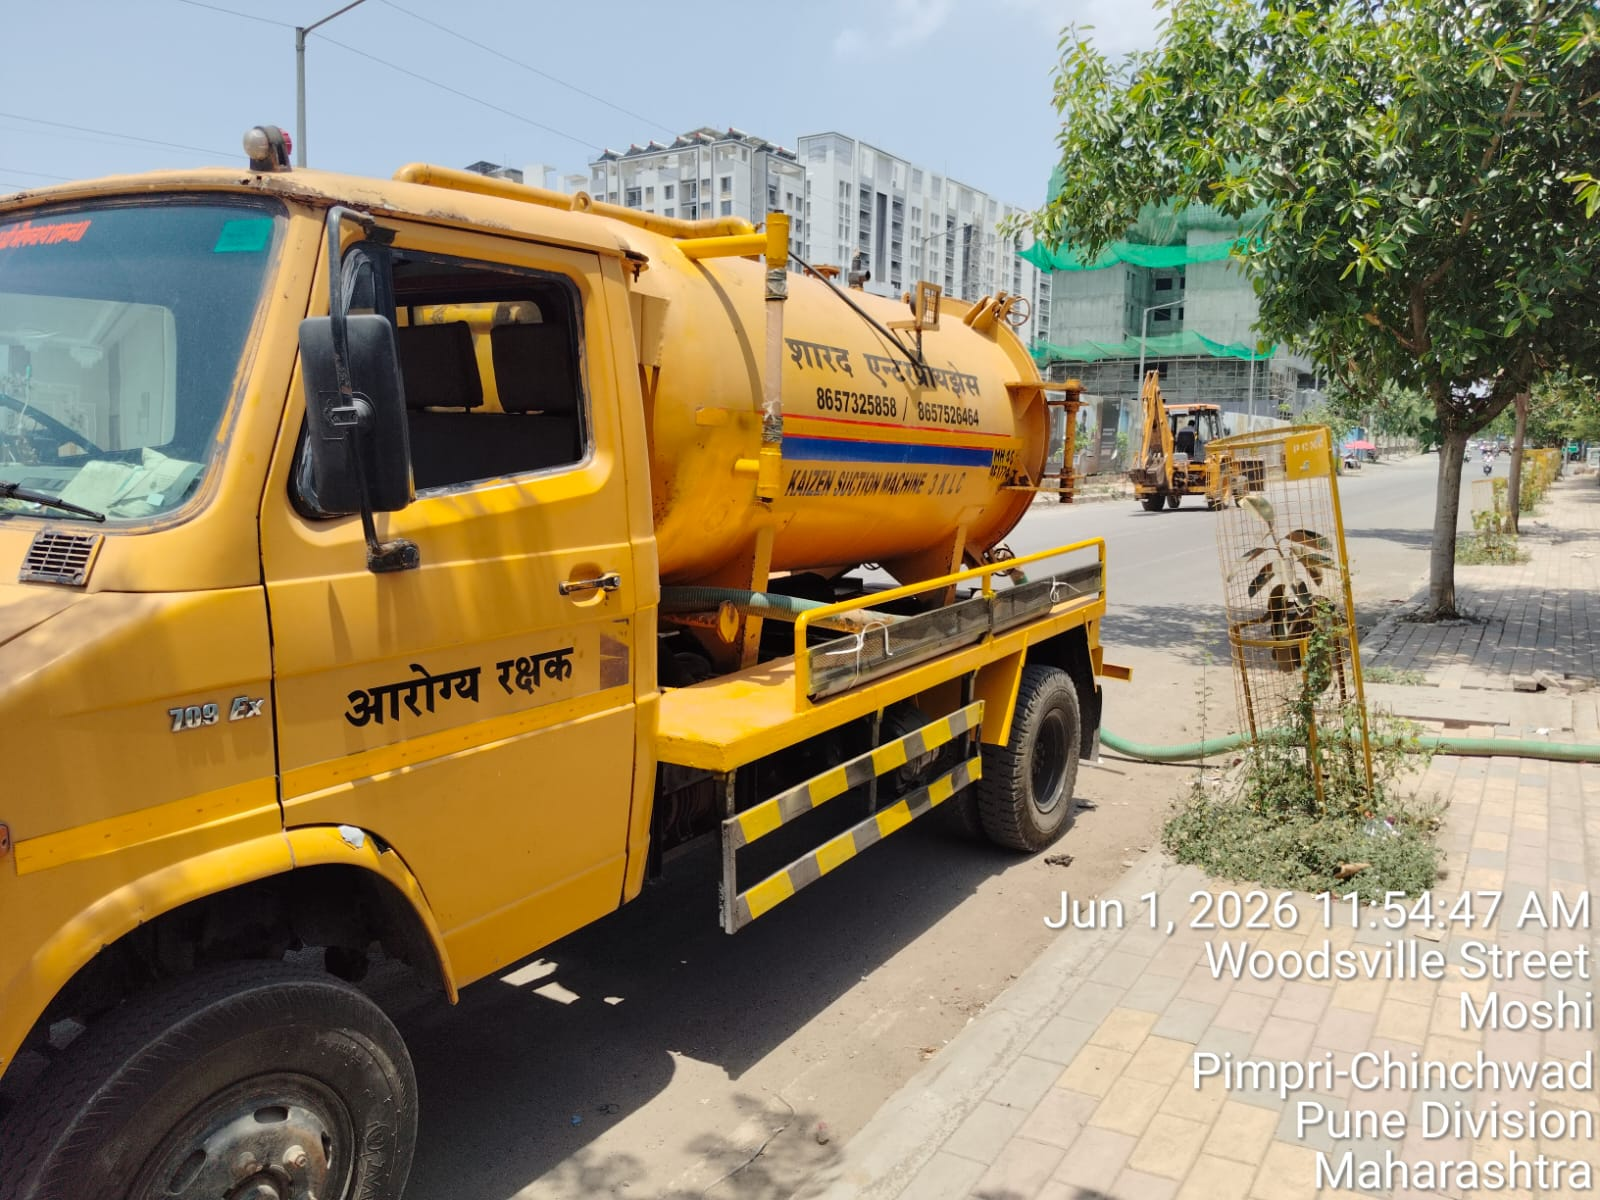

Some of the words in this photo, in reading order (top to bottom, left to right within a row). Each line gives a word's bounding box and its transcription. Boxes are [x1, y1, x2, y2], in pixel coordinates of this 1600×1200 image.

[784, 337, 853, 378] शारद
[816, 387, 897, 418] 8657325858
[917, 401, 979, 426] 8657526464
[784, 469, 837, 497] KAIZEN
[832, 471, 882, 497] SUCTION
[879, 471, 928, 496] MACHINE
[344, 663, 481, 727] आरोग्य
[496, 647, 574, 695] रक्षक
[168, 703, 219, 732] 709
[229, 696, 264, 721] Ex
